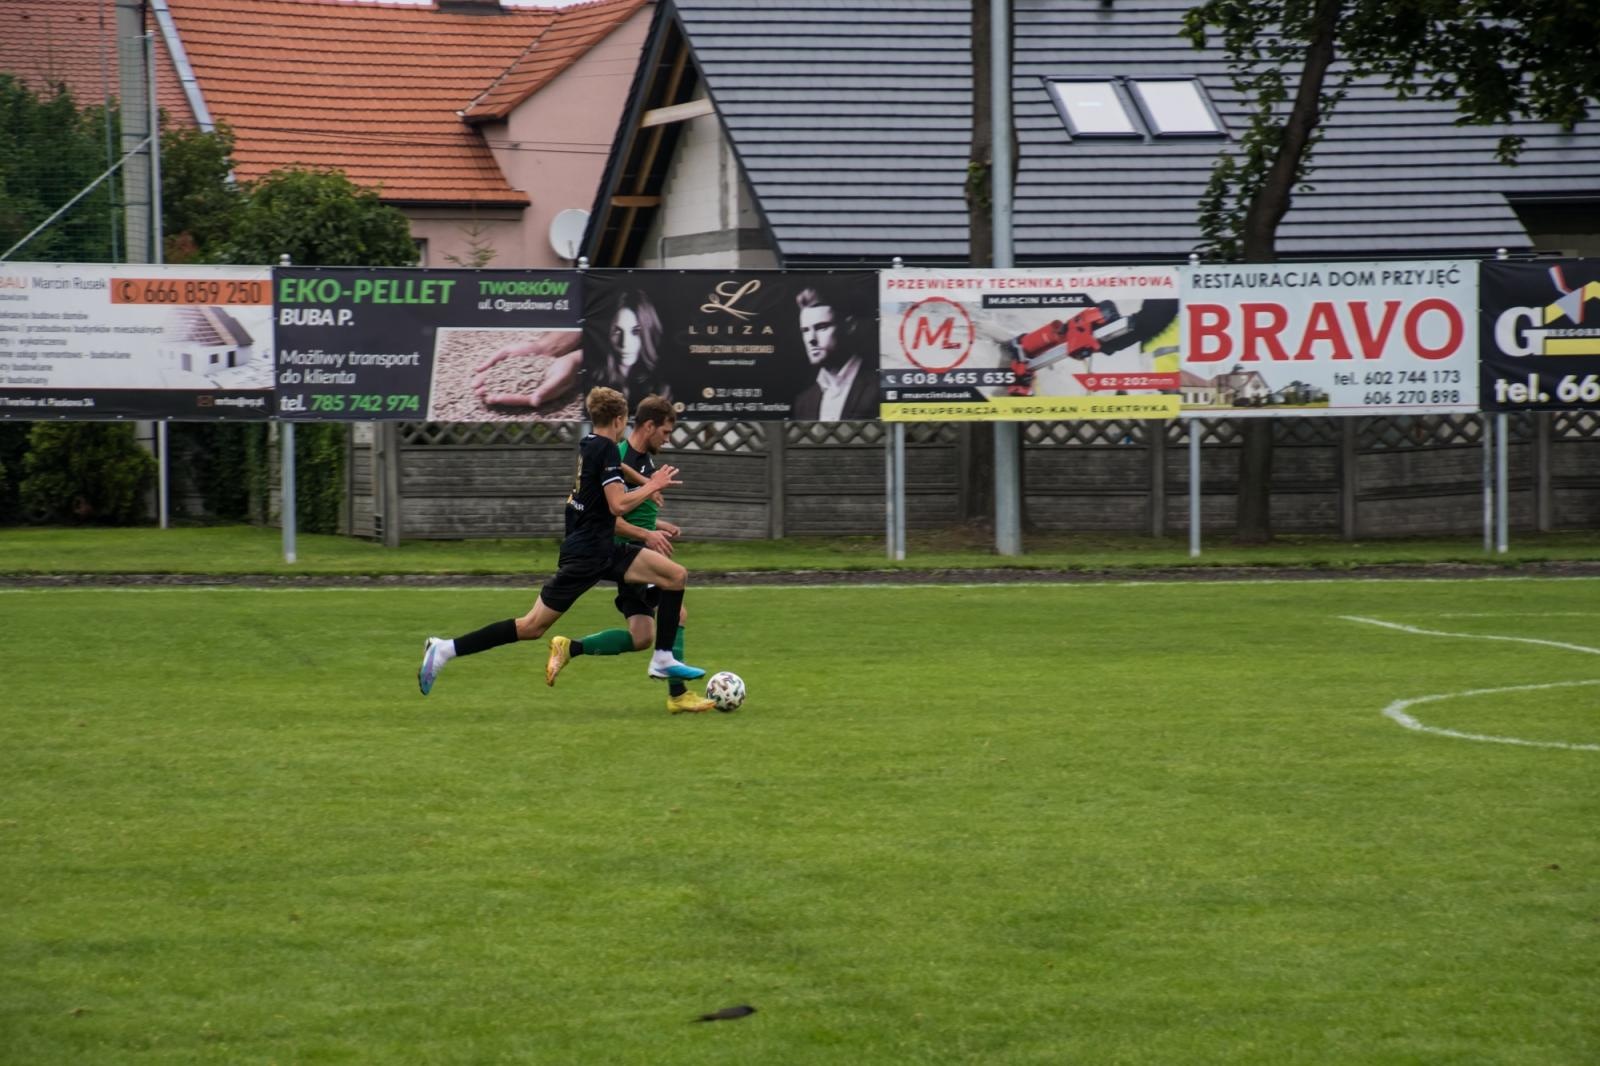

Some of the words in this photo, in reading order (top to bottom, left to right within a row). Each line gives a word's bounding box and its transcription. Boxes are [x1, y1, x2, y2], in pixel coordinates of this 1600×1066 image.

[32, 276, 69, 289] Marcin
[886, 279, 983, 289] PRZEWIERTY
[990, 278, 1065, 289] TECHNIKĄ
[1070, 276, 1173, 288] DIAMENTOWĄ
[1192, 272, 1321, 289] RESTAURACJA
[1328, 271, 1376, 287] DOM
[1382, 265, 1461, 288] PRZYJĘĆ
[144, 281, 178, 302] 666
[185, 282, 220, 302] 859
[227, 282, 262, 303] 250
[279, 278, 456, 304] EKO-PELLET
[478, 279, 570, 295] TWORKÓW
[478, 299, 494, 310] ul.
[495, 299, 553, 311] Ogrodowa
[1042, 296, 1085, 304] LASAK
[279, 308, 334, 326] BUBA
[337, 308, 355, 326] P.
[688, 325, 774, 335] LUIZA
[1186, 298, 1464, 362] BRAVO
[279, 350, 345, 367] Możliwy
[348, 351, 420, 368] transport
[279, 370, 301, 384] do
[304, 369, 356, 384] klienta
[902, 373, 938, 384] 608
[942, 373, 977, 384] 465
[982, 372, 1016, 384] 635
[1334, 372, 1357, 385] tel.
[1364, 372, 1392, 385] 602
[1398, 372, 1427, 384] 744
[1433, 370, 1461, 384] 173
[1494, 373, 1550, 403] tel.
[1556, 374, 1600, 403] 66
[279, 395, 306, 411] tel.
[310, 395, 345, 411] 785
[350, 395, 382, 411] 742
[386, 395, 419, 411] 974
[1364, 392, 1392, 405] 606
[1399, 391, 1427, 404] 270
[1431, 390, 1460, 404] 898
[901, 407, 999, 415] REKUPERACJA
[1011, 405, 1078, 414] WOD-KAN
[1090, 405, 1169, 413] ELEKTRYKA
